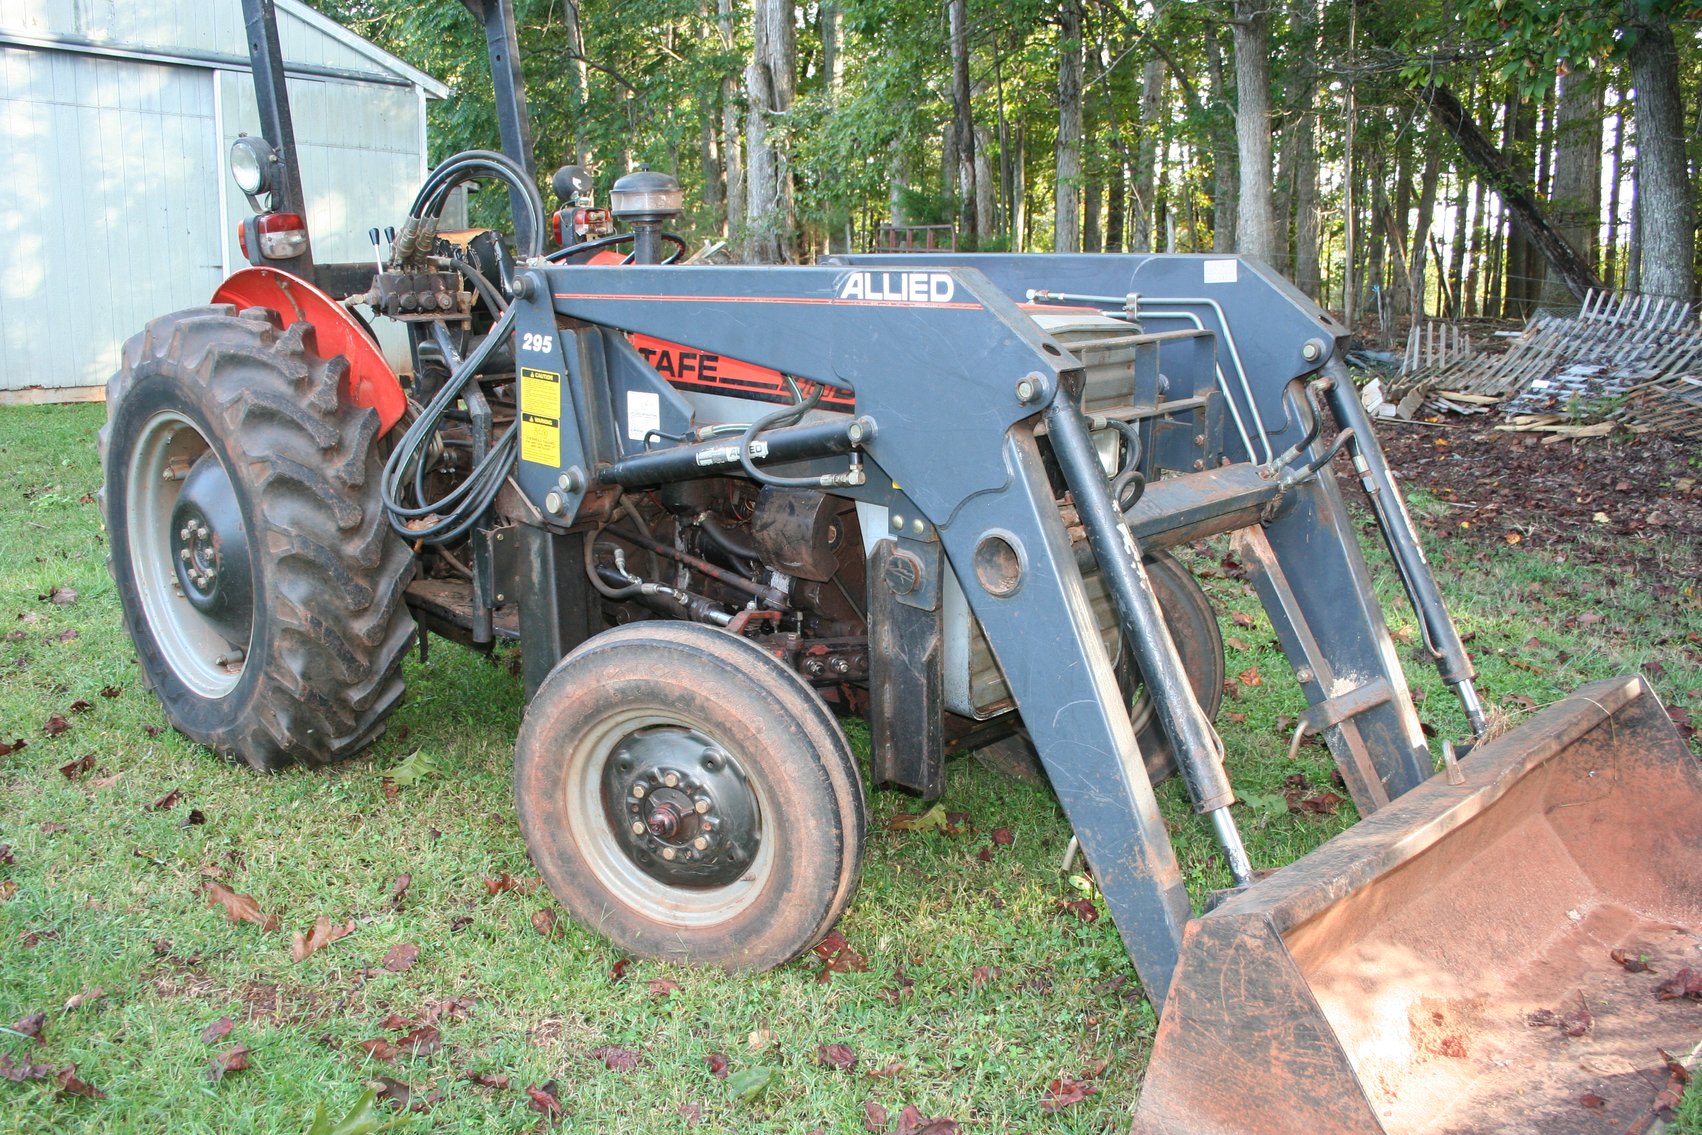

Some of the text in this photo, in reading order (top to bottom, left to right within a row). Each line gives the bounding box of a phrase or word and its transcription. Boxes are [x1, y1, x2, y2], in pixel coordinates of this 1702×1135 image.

[840, 272, 954, 302] ALLIED
[522, 332, 553, 354] 295
[638, 348, 719, 383] TAFE
[729, 444, 764, 458] ALED
